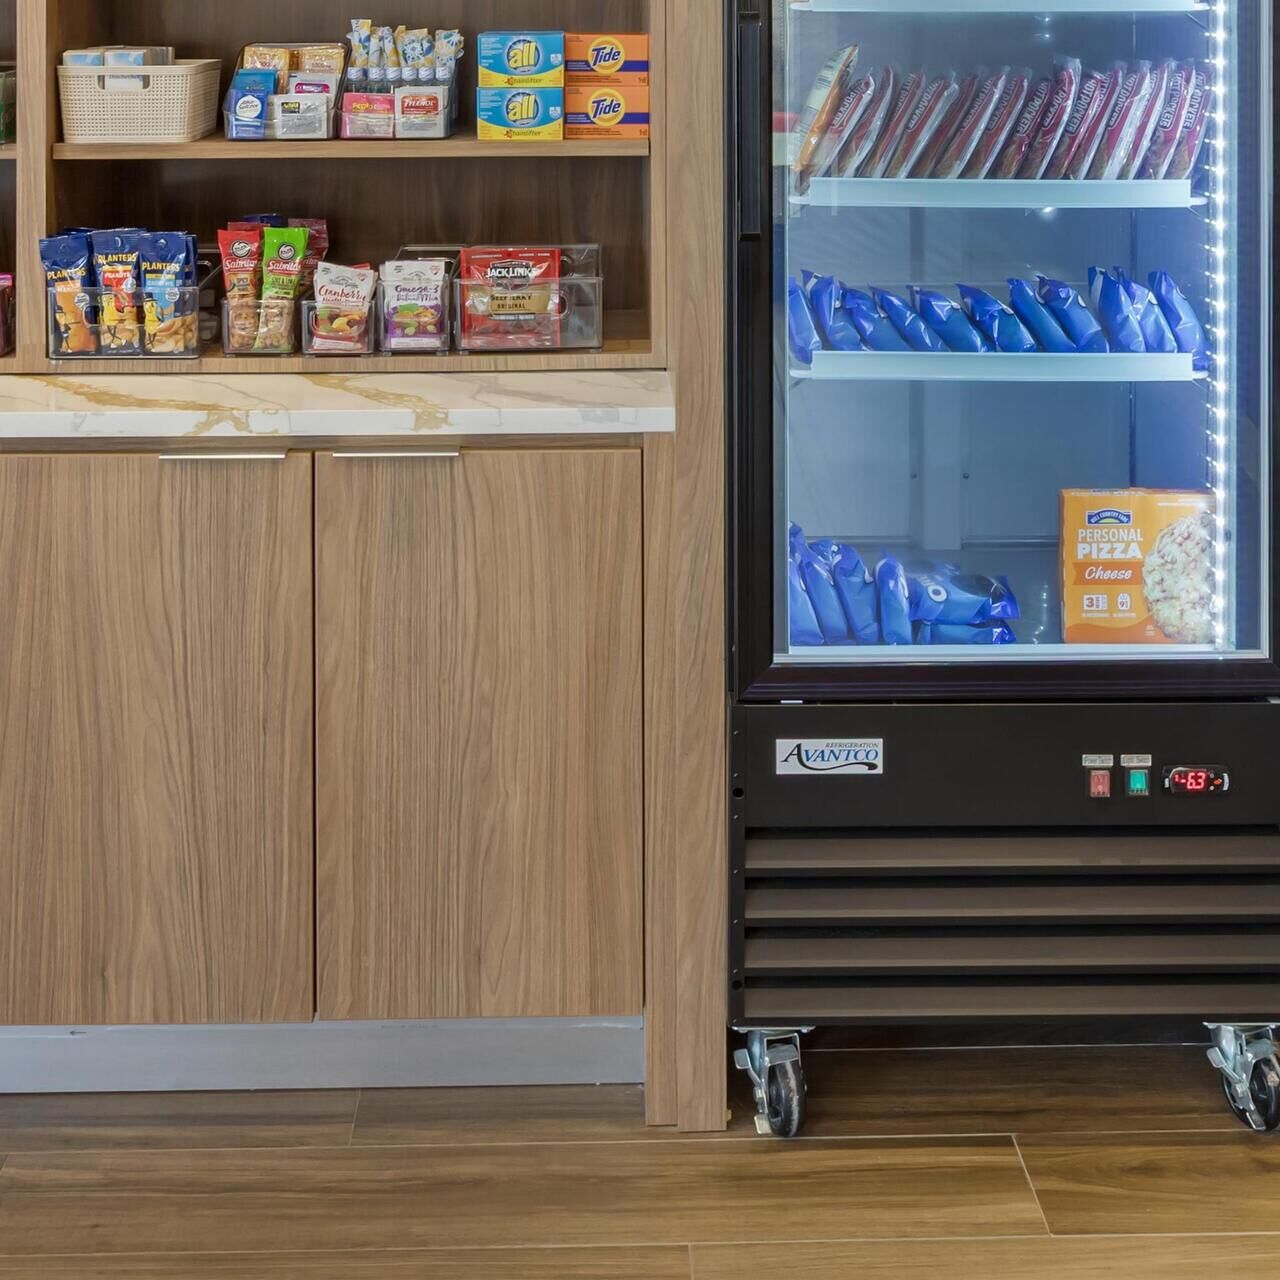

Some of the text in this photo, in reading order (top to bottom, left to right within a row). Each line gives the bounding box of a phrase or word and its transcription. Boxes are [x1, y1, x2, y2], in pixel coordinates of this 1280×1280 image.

[508, 41, 537, 69] all
[591, 46, 621, 66] Tide
[507, 94, 536, 121] all
[591, 98, 621, 119] Tide
[1017, 96, 1042, 135] POCKETS
[1066, 91, 1091, 133] POCKETS
[1160, 87, 1182, 129] POCKETS
[98, 254, 137, 263] PLANTERS
[142, 262, 180, 272] PLANTERS
[225, 259, 258, 270] Sabritas
[269, 260, 302, 271] Sabritas
[48, 268, 87, 280] PLANTERS
[486, 267, 508, 278] JACK
[318, 284, 367, 302] Cranberry
[395, 284, 440, 293] Omega-3
[1078, 528, 1143, 542] PERSONAL
[1077, 542, 1143, 559] PIZZA
[1084, 566, 1133, 580] Cheese
[781, 743, 879, 767] AVANTCO
